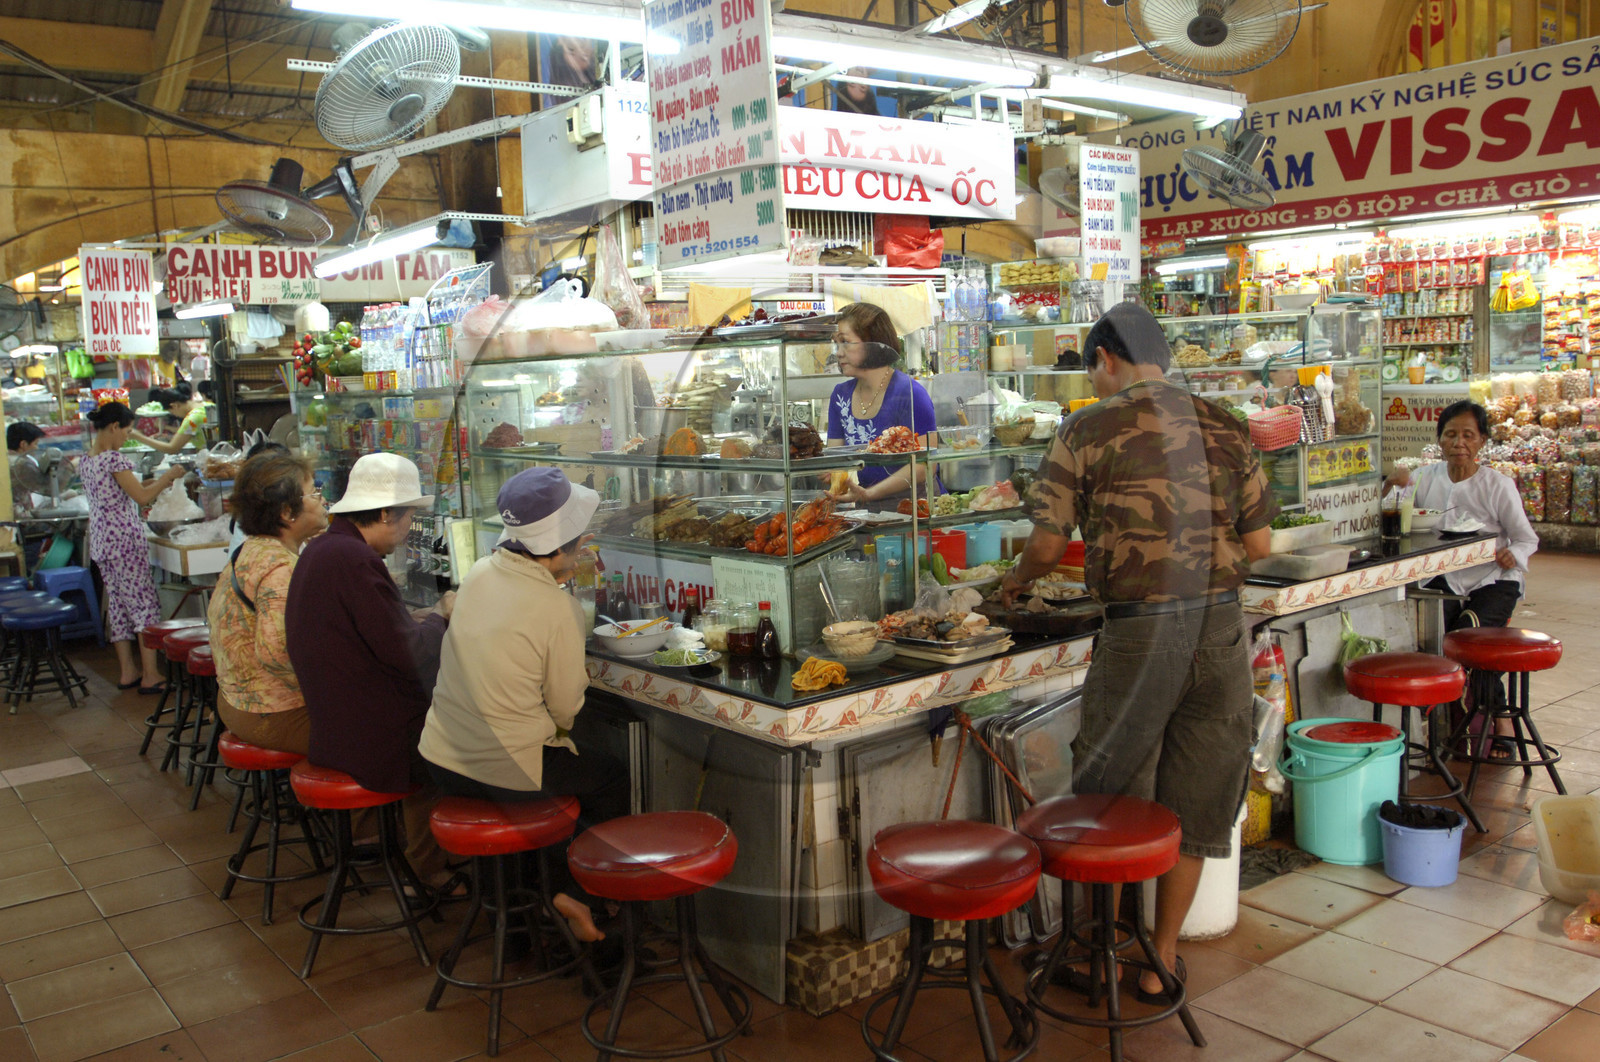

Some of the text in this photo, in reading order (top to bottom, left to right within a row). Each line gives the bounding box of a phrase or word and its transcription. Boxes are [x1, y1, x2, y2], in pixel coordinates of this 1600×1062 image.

[705, 13, 714, 44] gà
[721, 28, 761, 75] MẮM
[679, 62, 692, 83] nam
[665, 91, 685, 124] quảng
[690, 86, 704, 111] Bún
[704, 82, 719, 111] mộc
[750, 97, 768, 125] 15000
[1125, 128, 1186, 151] CÔNG
[1287, 100, 1342, 125] NAM
[1350, 87, 1386, 115] KỸ
[1393, 72, 1477, 107] NGHỆ
[1485, 60, 1552, 91] SÚC
[658, 130, 671, 153] Bún
[672, 126, 680, 150] bò
[660, 157, 672, 184] Chả
[673, 153, 683, 186] giò
[694, 146, 711, 175] cuốn
[715, 142, 727, 170] Gỏi
[728, 137, 745, 163] cuốn
[1116, 152, 1132, 161] CHAY
[661, 192, 675, 215] Bún
[675, 191, 691, 212] nem
[694, 182, 709, 211] Thịt
[854, 168, 932, 203] CUA
[951, 166, 997, 207] ỐC
[1104, 179, 1116, 192] CHAY
[1313, 197, 1352, 222] ĐỒ
[1356, 193, 1415, 217] HỘP
[1434, 180, 1501, 207] CHẢ
[1508, 172, 1571, 199] GIÒ
[756, 199, 775, 227] 50000
[1103, 198, 1115, 212] CHAY
[663, 216, 710, 246] Bún tôm càng
[167, 246, 318, 279] CANH BÚN
[395, 250, 451, 281] TẤM
[451, 252, 469, 260] 1152
[85, 253, 150, 292] CANH BÚN
[168, 275, 203, 304] BÚN
[90, 293, 152, 336] BÚN RIÊU
[92, 335, 121, 352] CUA ỐC
[1396, 424, 1408, 432] GIÒ
[1409, 424, 1424, 432] CÁC
[1307, 486, 1379, 514] BÁNH CANH CUA
[616, 565, 660, 605] ÁNH
